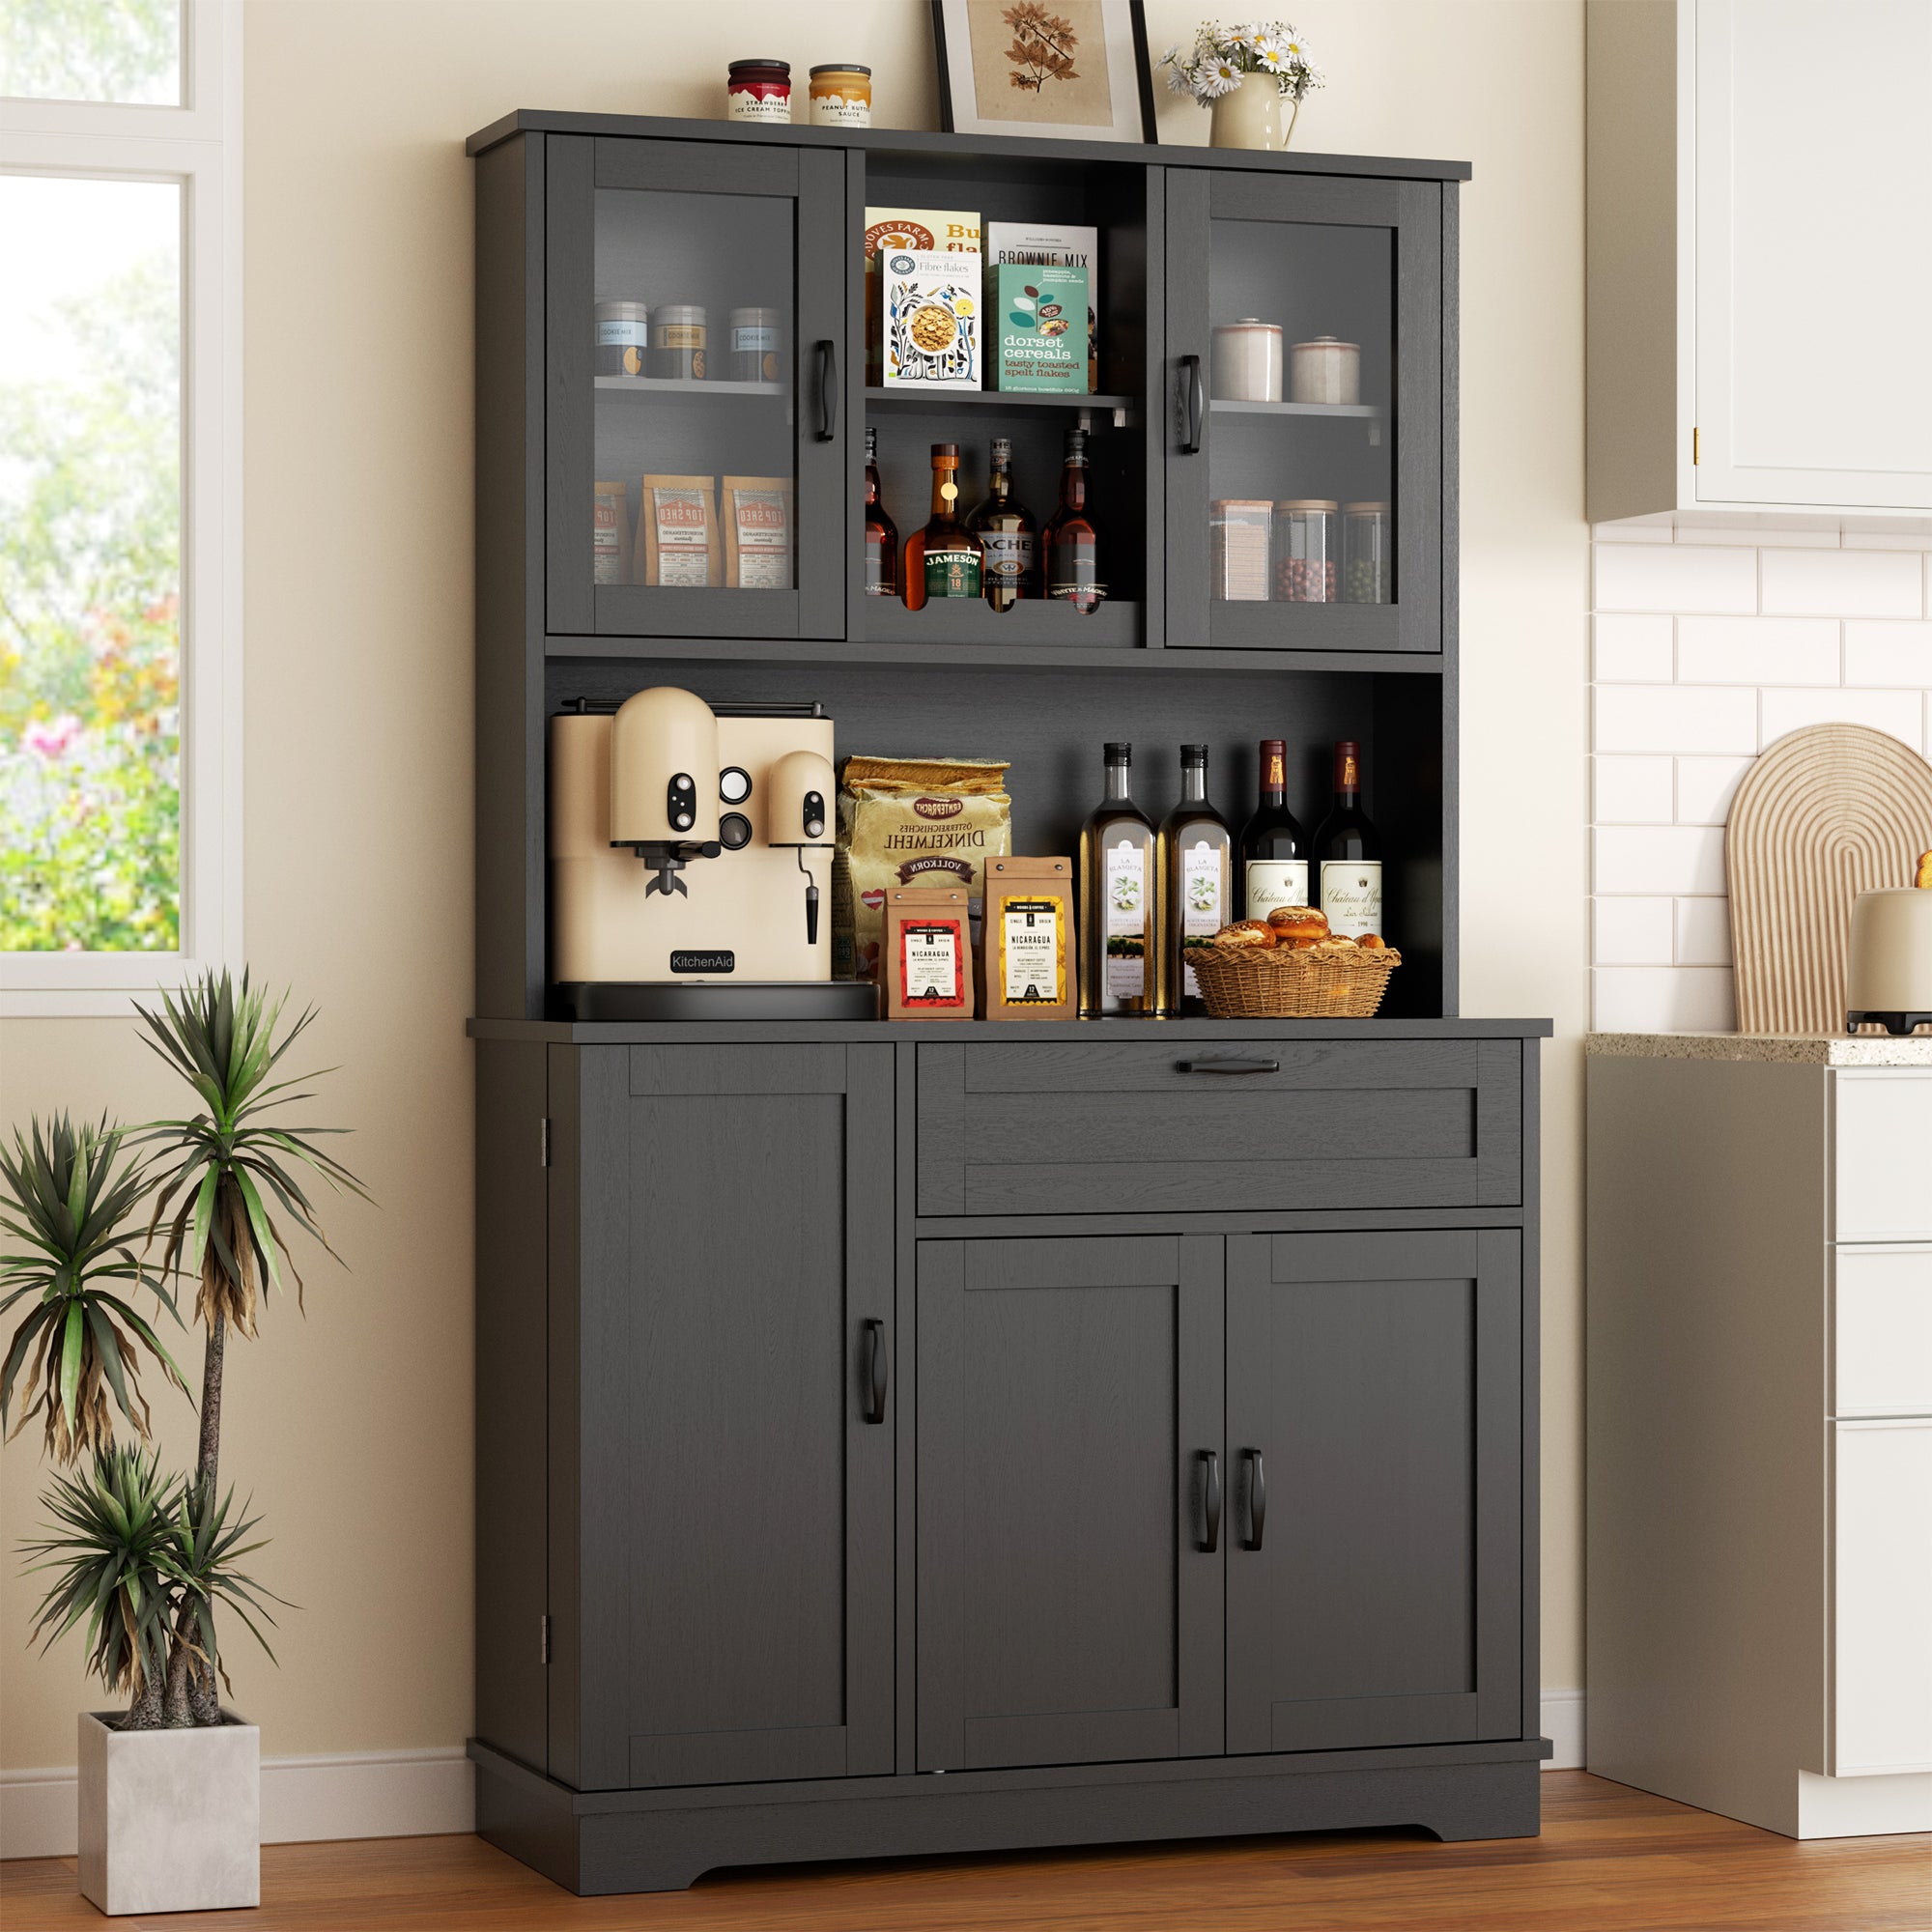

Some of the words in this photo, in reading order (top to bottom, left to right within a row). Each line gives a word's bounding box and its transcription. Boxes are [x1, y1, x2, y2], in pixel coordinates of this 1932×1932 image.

[897, 223, 929, 243] FARM
[999, 250, 1057, 266] BROWNIE
[1065, 253, 1088, 268] MIX
[920, 262, 942, 271] Fibre
[944, 262, 969, 272] flakes
[1005, 335, 1064, 348] dorset
[1005, 349, 1071, 360] cereals
[1005, 359, 1035, 369] tasty
[1037, 360, 1080, 370] toasted
[1005, 369, 1034, 378] spelt
[1036, 369, 1070, 378] flakes
[926, 554, 979, 566] JAMESON
[951, 579, 961, 587] 18
[1011, 935, 1051, 944] NICARAGUA
[672, 955, 734, 967] KitchenAid
